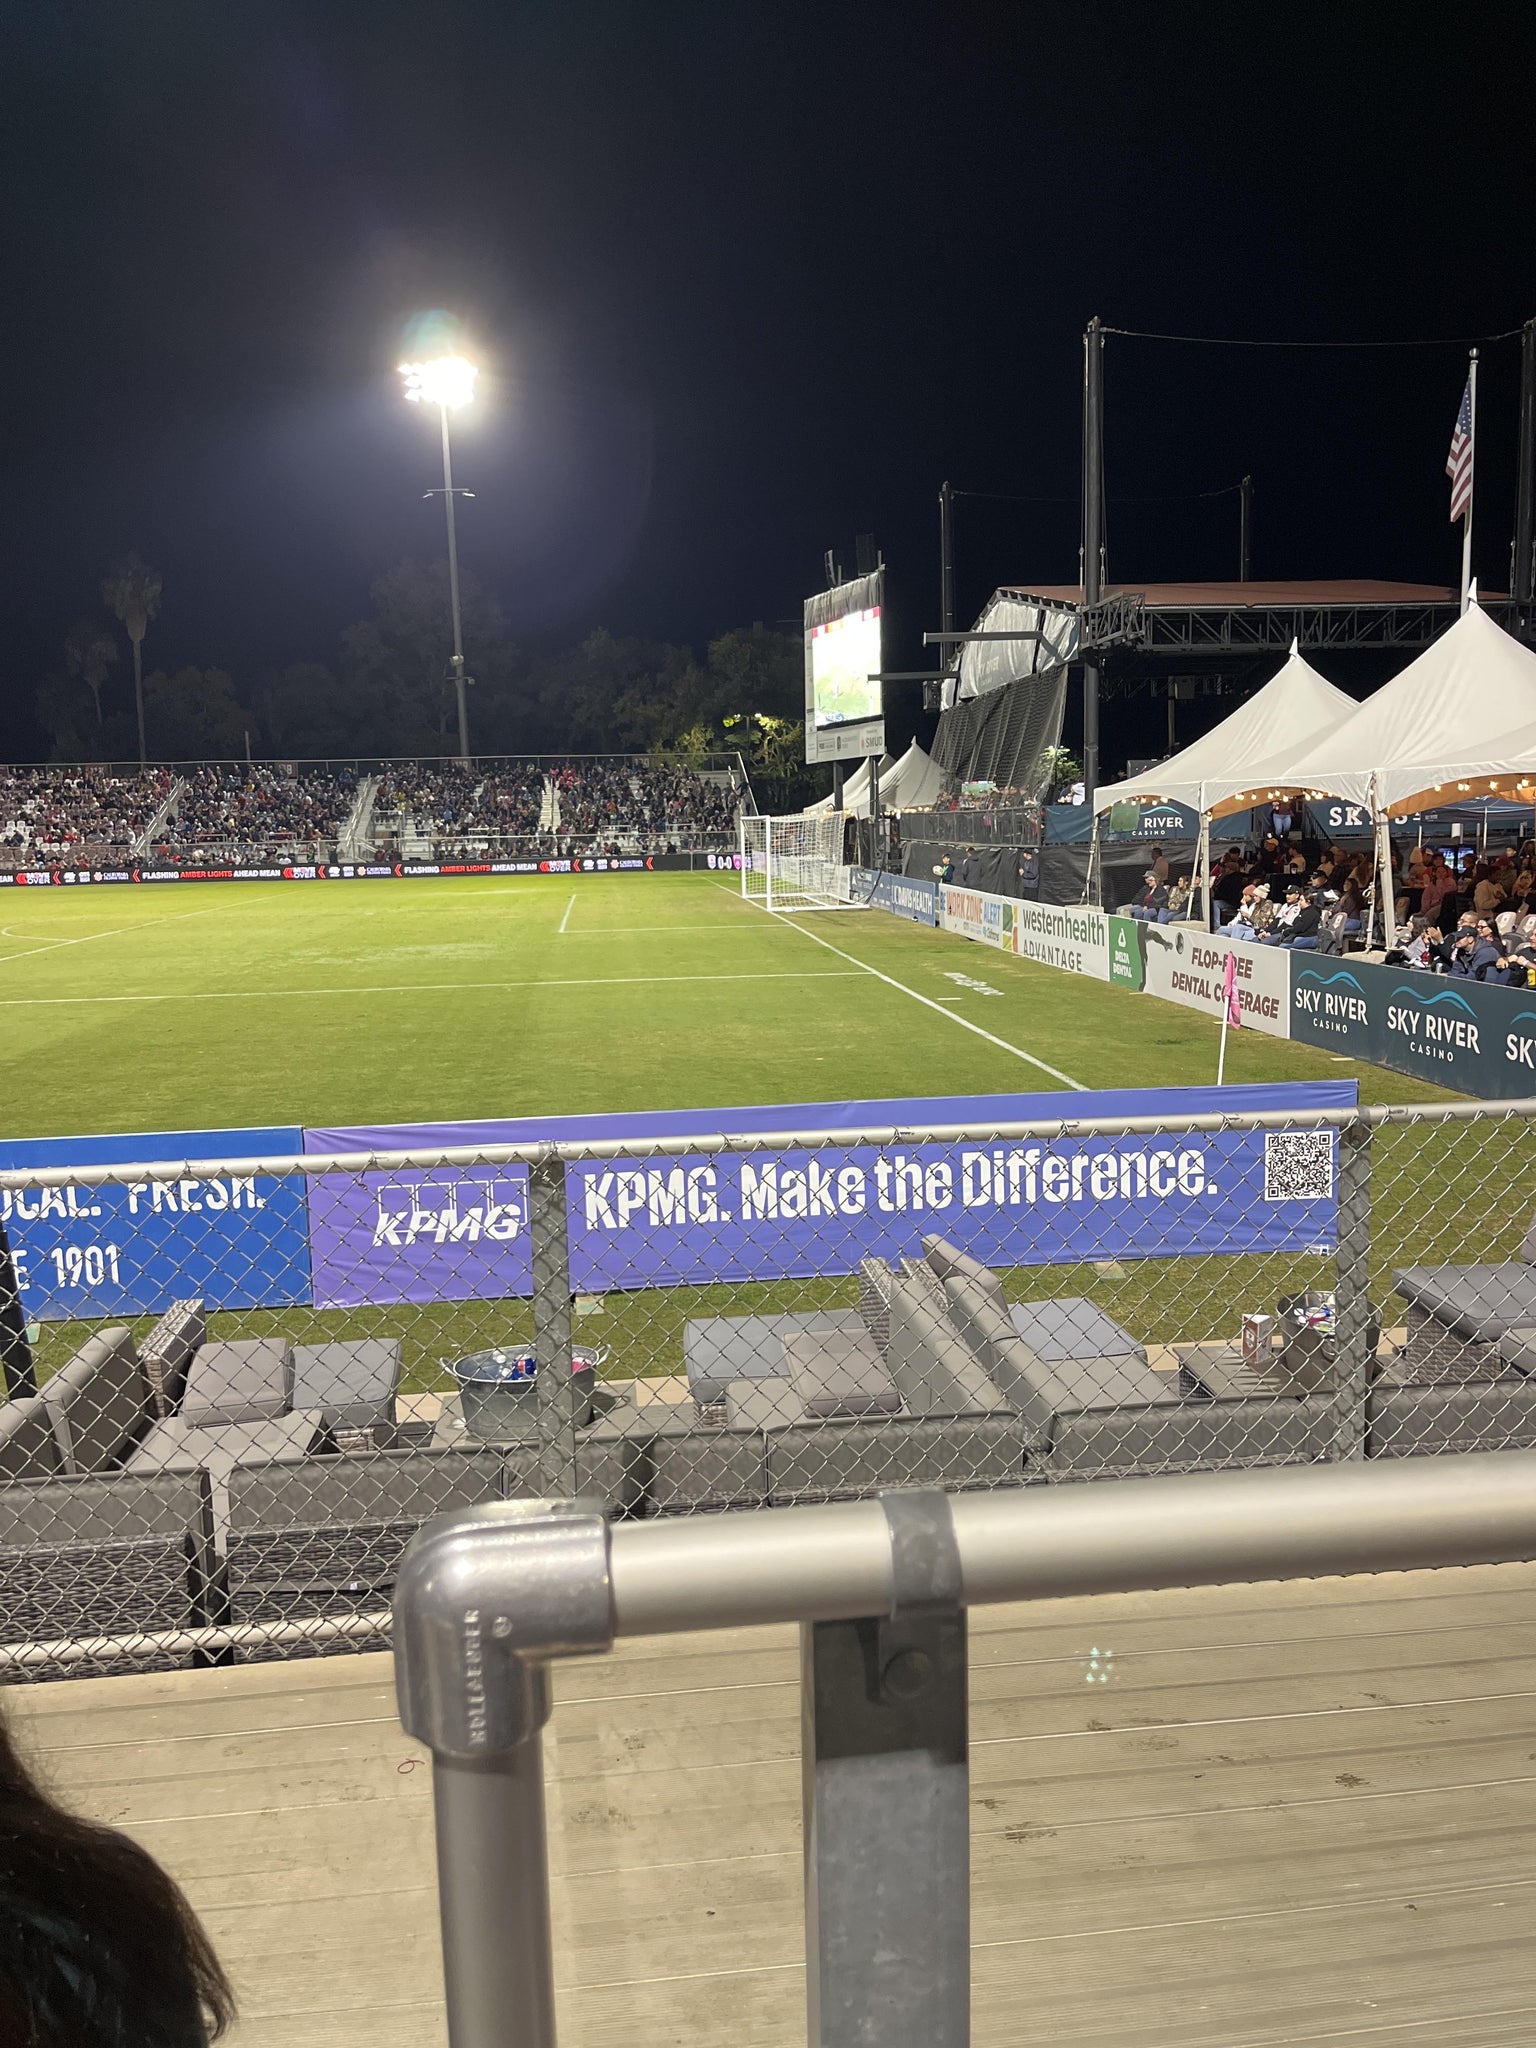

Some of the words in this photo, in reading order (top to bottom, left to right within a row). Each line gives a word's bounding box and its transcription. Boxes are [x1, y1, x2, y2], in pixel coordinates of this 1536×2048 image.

[1144, 816, 1184, 828] RIVER
[142, 871, 179, 880] FLASHING
[179, 870, 207, 879] AMBER
[207, 870, 233, 879] LIGHTS
[233, 869, 258, 878] AHEAD
[259, 869, 281, 877] MEAN
[403, 865, 440, 874] FLASHING
[440, 864, 466, 873] AMBER
[466, 864, 491, 872] LIGHTS
[491, 863, 516, 872] AHEAD
[516, 862, 538, 871] MEAN
[912, 889, 933, 915] HEALTH
[965, 894, 983, 925] ZONE
[1023, 939, 1082, 972] ADVANTAGE
[1171, 970, 1212, 999] DENTAL
[1213, 982, 1280, 1019] CERAGE
[1295, 987, 1321, 1013] SKY
[1325, 992, 1369, 1026] RIVER
[1313, 1017, 1349, 1034] CASINO
[1387, 1005, 1420, 1036] SKY
[1425, 1014, 1480, 1054] RIVER
[1410, 1041, 1454, 1063] CASINO
[1505, 1033, 1536, 1069] SK
[0, 1186, 101, 1221] CAL.
[584, 1165, 732, 1230] KPMG.
[740, 1160, 866, 1221] Make
[874, 1154, 953, 1212] the
[961, 1148, 1218, 1207] Difference.
[374, 1204, 521, 1247] KPMG
[51, 1245, 119, 1288] 1901
